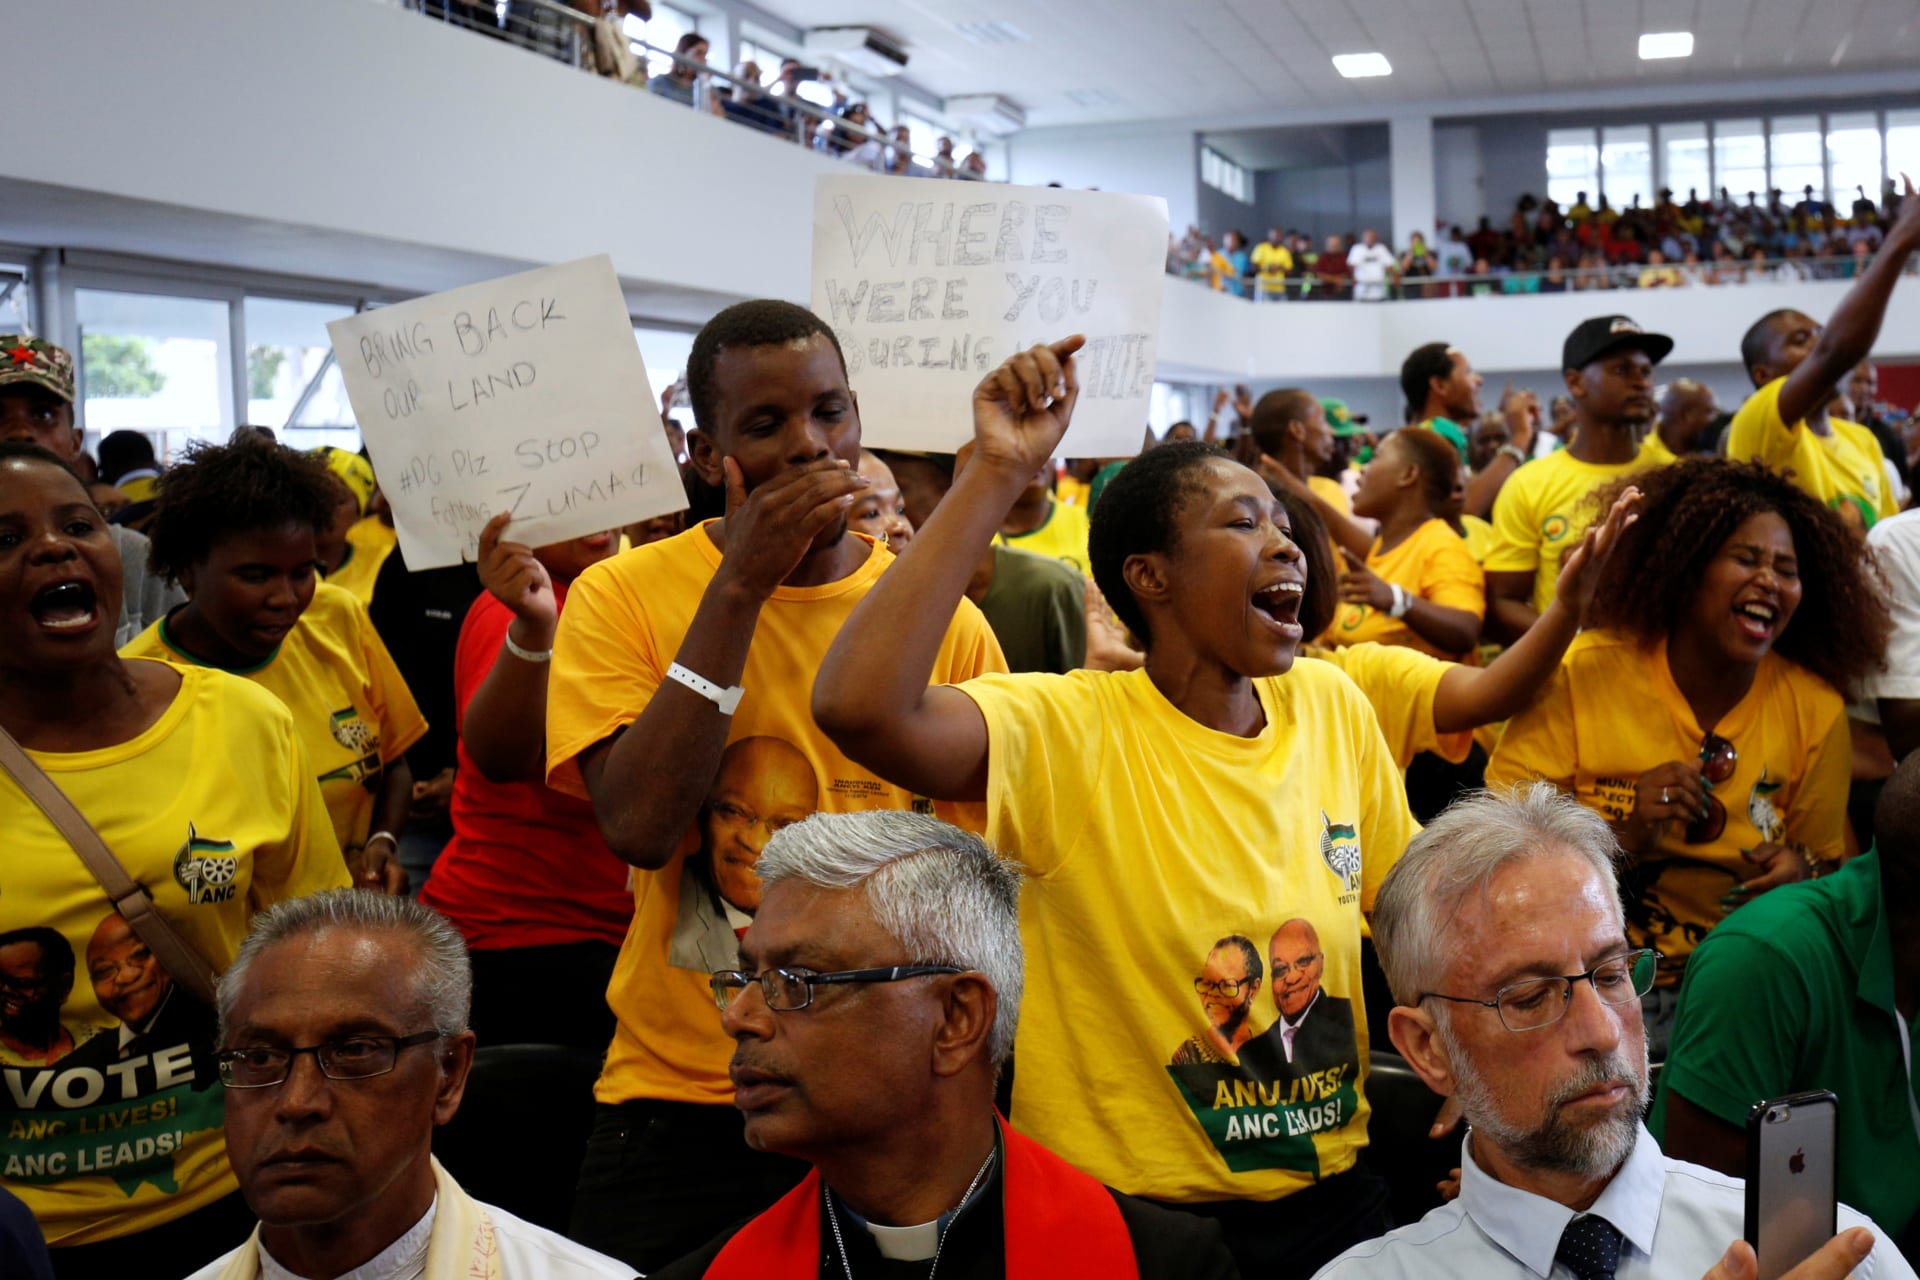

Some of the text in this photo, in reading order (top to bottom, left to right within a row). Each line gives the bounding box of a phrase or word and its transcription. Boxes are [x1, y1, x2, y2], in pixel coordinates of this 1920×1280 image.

[833, 194, 1072, 269] WHERE
[825, 272, 1099, 326] WERE YOU
[360, 298, 566, 379] BRING BACK
[384, 362, 536, 420] OUR LAND
[200, 885, 236, 905] ANC
[2, 1042, 196, 1110] VOTE
[8, 1097, 177, 1141] ANC LIVES!
[1225, 1112, 1281, 1141] ANC
[4, 1130, 183, 1177] ANC LEADS!
